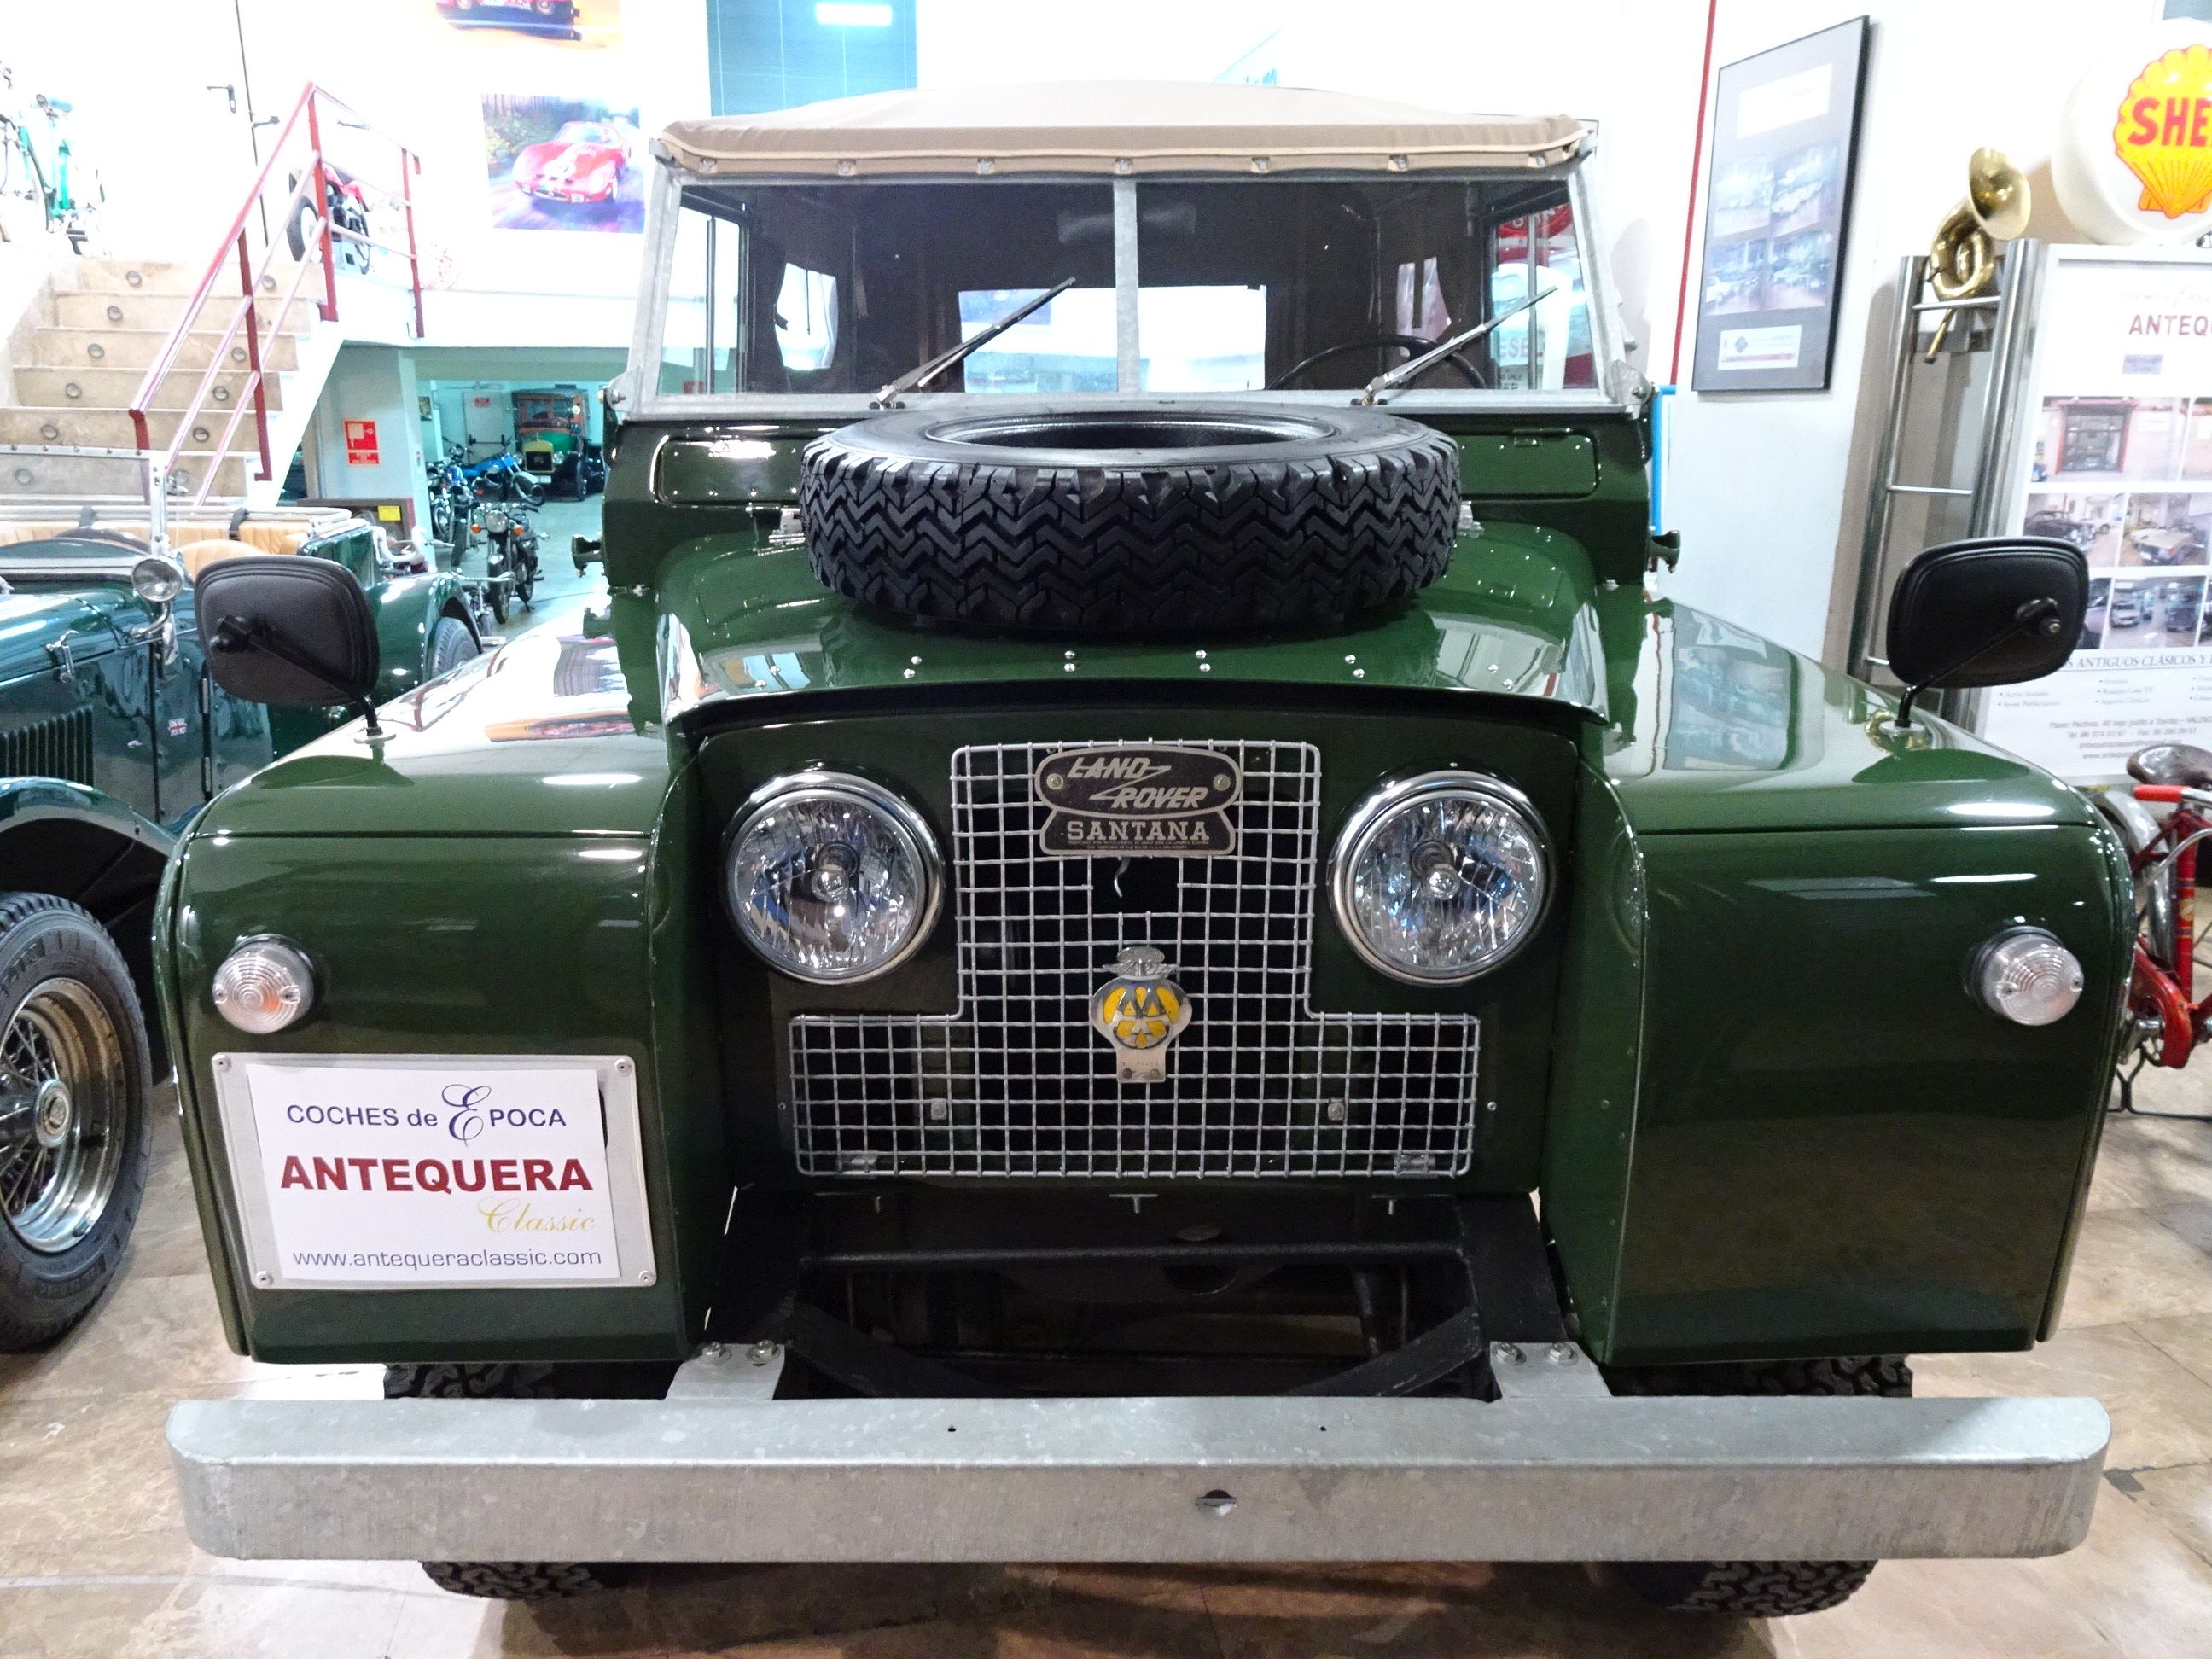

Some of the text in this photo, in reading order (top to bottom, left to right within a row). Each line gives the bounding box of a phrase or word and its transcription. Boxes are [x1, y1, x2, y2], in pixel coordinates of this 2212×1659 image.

[2128, 313, 2212, 337] ANTEQ
[1067, 756, 1151, 779] LAND
[1110, 786, 1209, 809] ROVER
[1067, 820, 1210, 841] SANTANA
[287, 1104, 399, 1126] COCHES
[406, 1108, 439, 1127] de
[280, 1155, 594, 1195] ANTEQUERA
[477, 1196, 596, 1233] Classic
[292, 1248, 602, 1272] www.antequeraclassic.com
